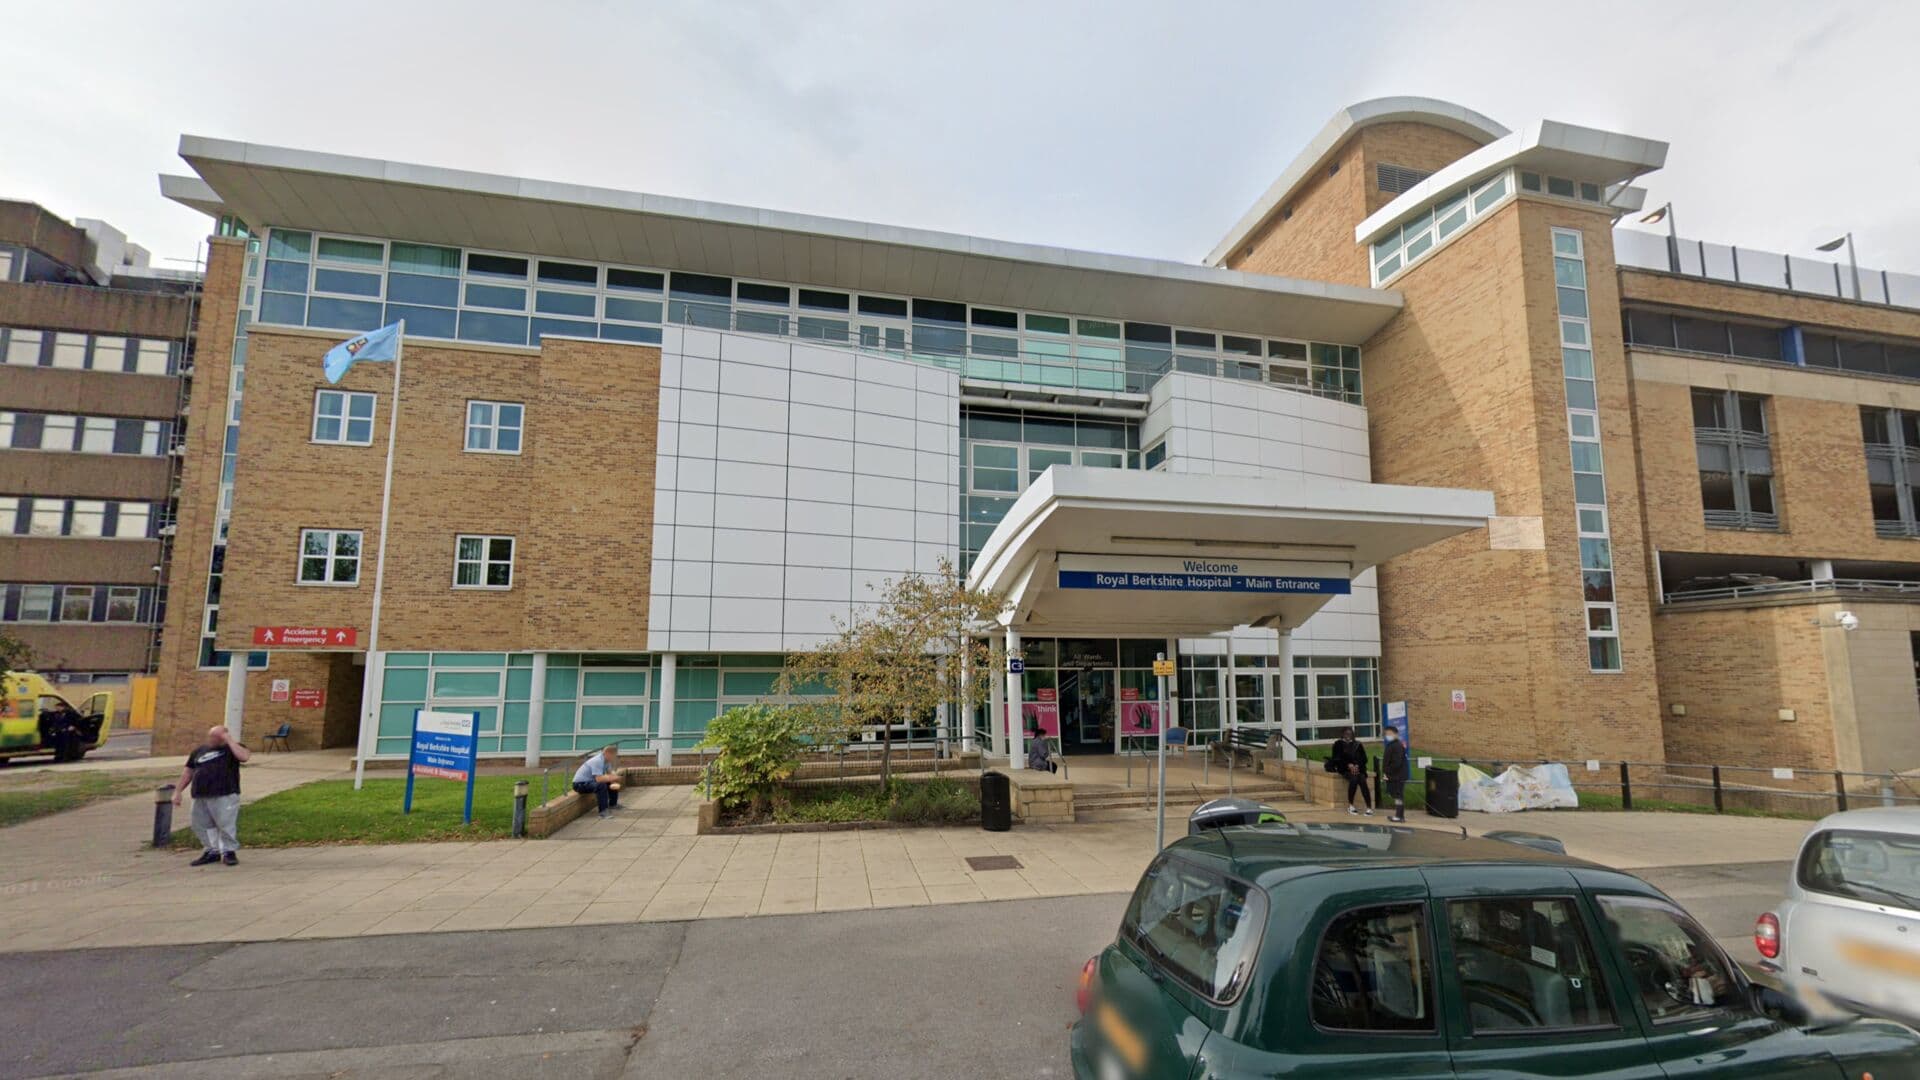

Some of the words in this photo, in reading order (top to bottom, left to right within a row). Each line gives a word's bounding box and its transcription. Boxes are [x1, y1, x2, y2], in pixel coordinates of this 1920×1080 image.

[1183, 560, 1238, 573] Welcome
[1096, 574, 1128, 588] Royal
[1132, 575, 1183, 587] Berkshire
[1187, 576, 1231, 589] Hospital
[1245, 577, 1272, 588] Main
[1276, 579, 1321, 589] Entrance
[282, 636, 326, 645] Emergency
[1011, 662, 1022, 670] C3
[1037, 704, 1056, 712] think
